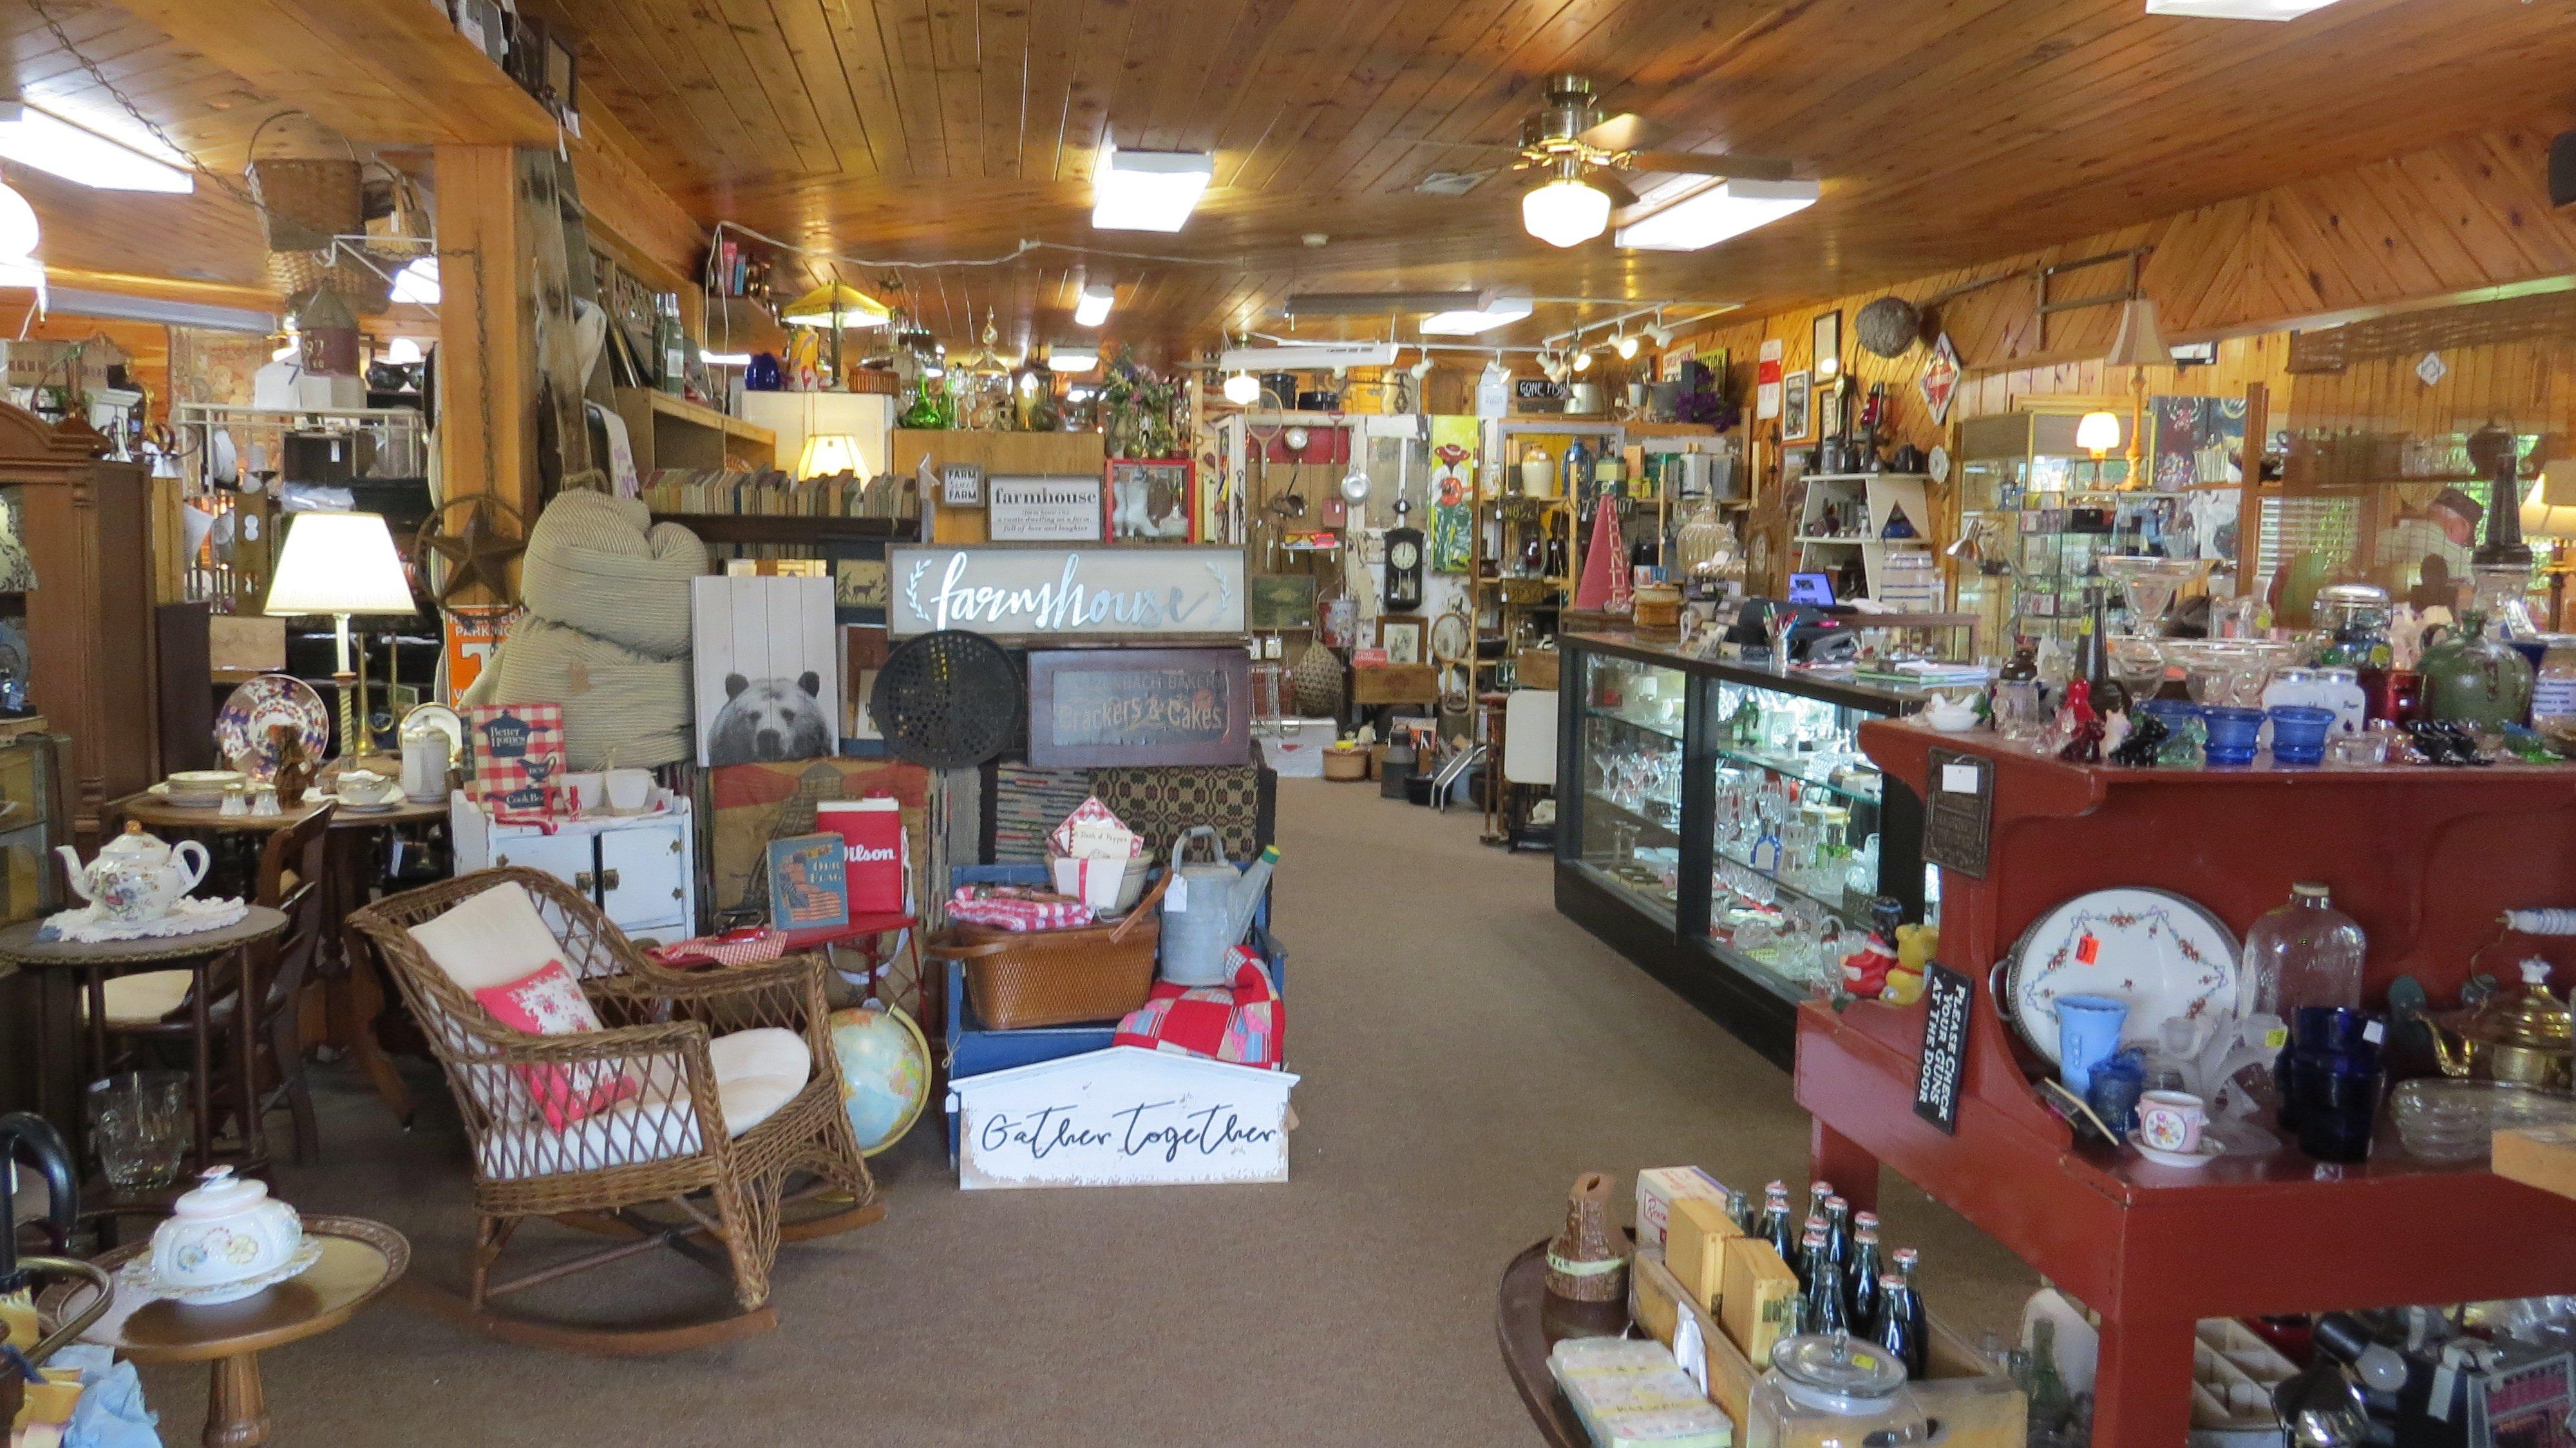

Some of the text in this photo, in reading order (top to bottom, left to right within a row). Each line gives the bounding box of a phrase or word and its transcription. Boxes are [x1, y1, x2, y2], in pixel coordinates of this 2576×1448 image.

[949, 470, 976, 480] FARM
[949, 490, 976, 500] FARM
[995, 487, 1095, 504] farmhouse
[930, 551, 1209, 631] farmhouse
[490, 726, 520, 736] Better
[1167, 694, 1222, 730] Cakes
[1918, 976, 1943, 1103] AT THE DOOR
[1929, 992, 1954, 1107] YOUR GUNS
[1938, 984, 1966, 1121] PLEASE CHECK
[981, 1100, 1277, 1162] Gather together
